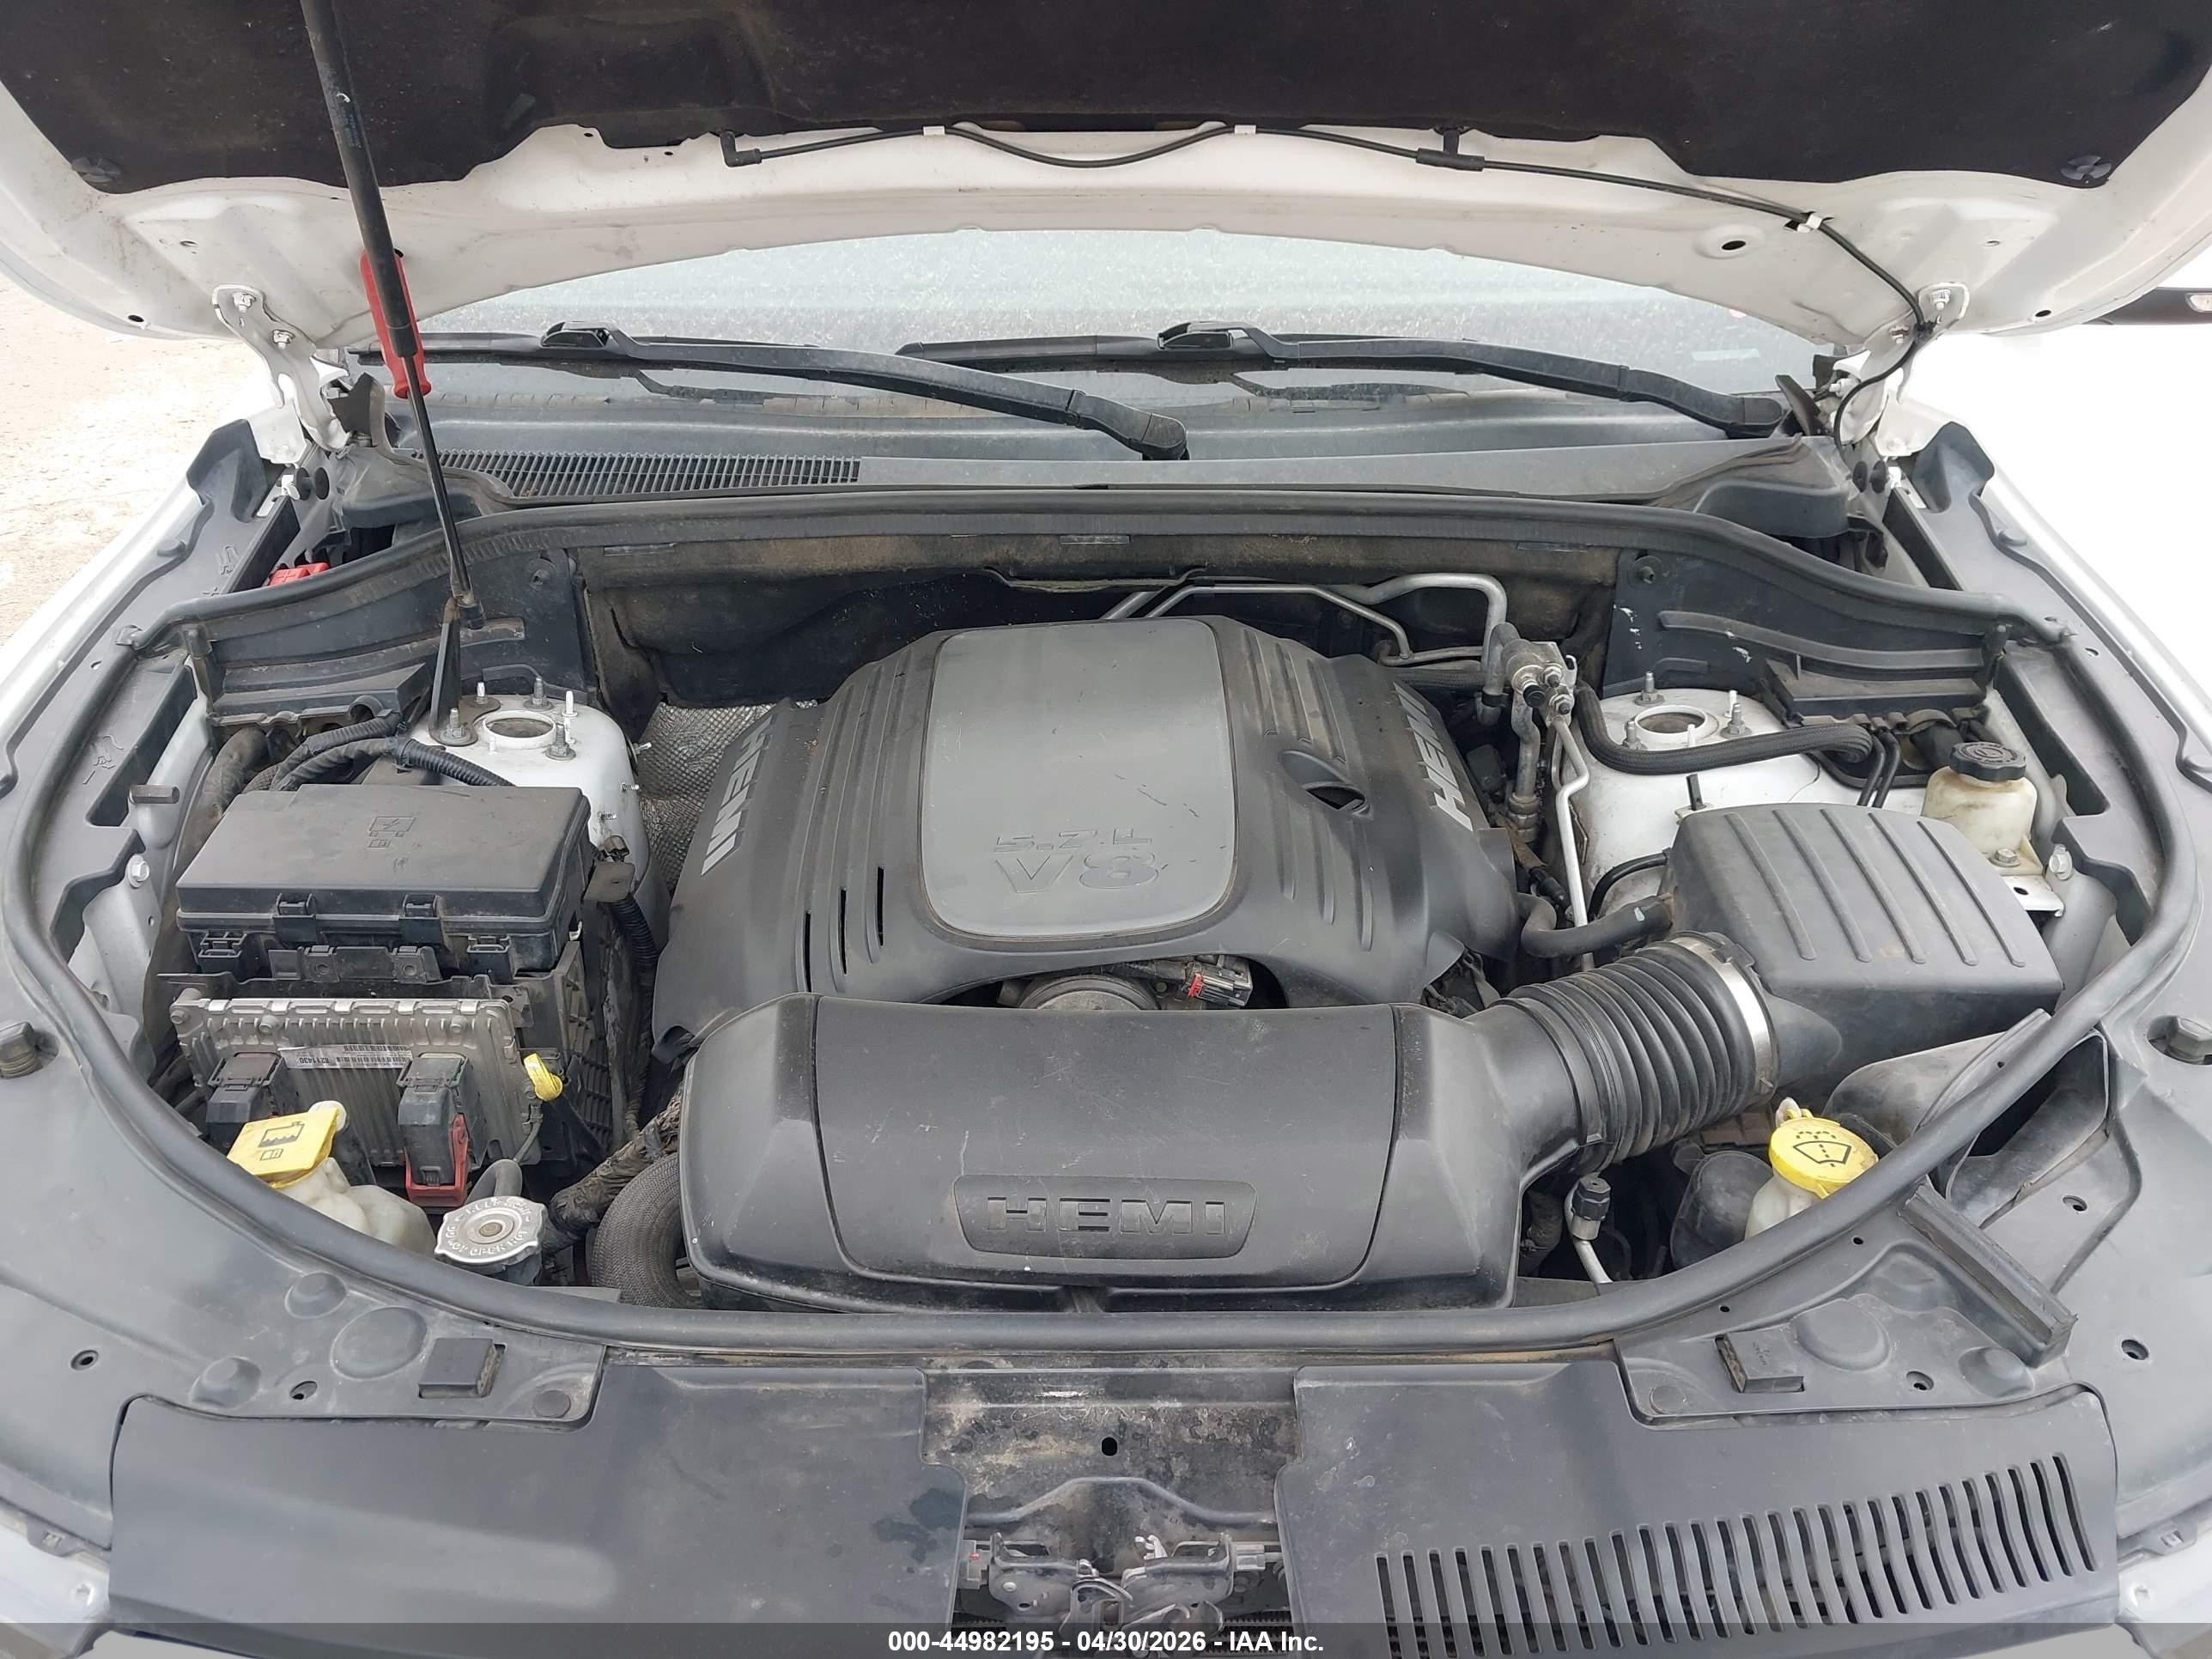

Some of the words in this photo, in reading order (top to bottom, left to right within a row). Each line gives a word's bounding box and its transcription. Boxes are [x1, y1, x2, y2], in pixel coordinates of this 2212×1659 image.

[1393, 681, 1474, 832] HEMI
[701, 714, 773, 877] HEMI
[994, 827, 1152, 852] 5.7L
[994, 852, 1159, 894] V8
[987, 1197, 1226, 1236] HEMI
